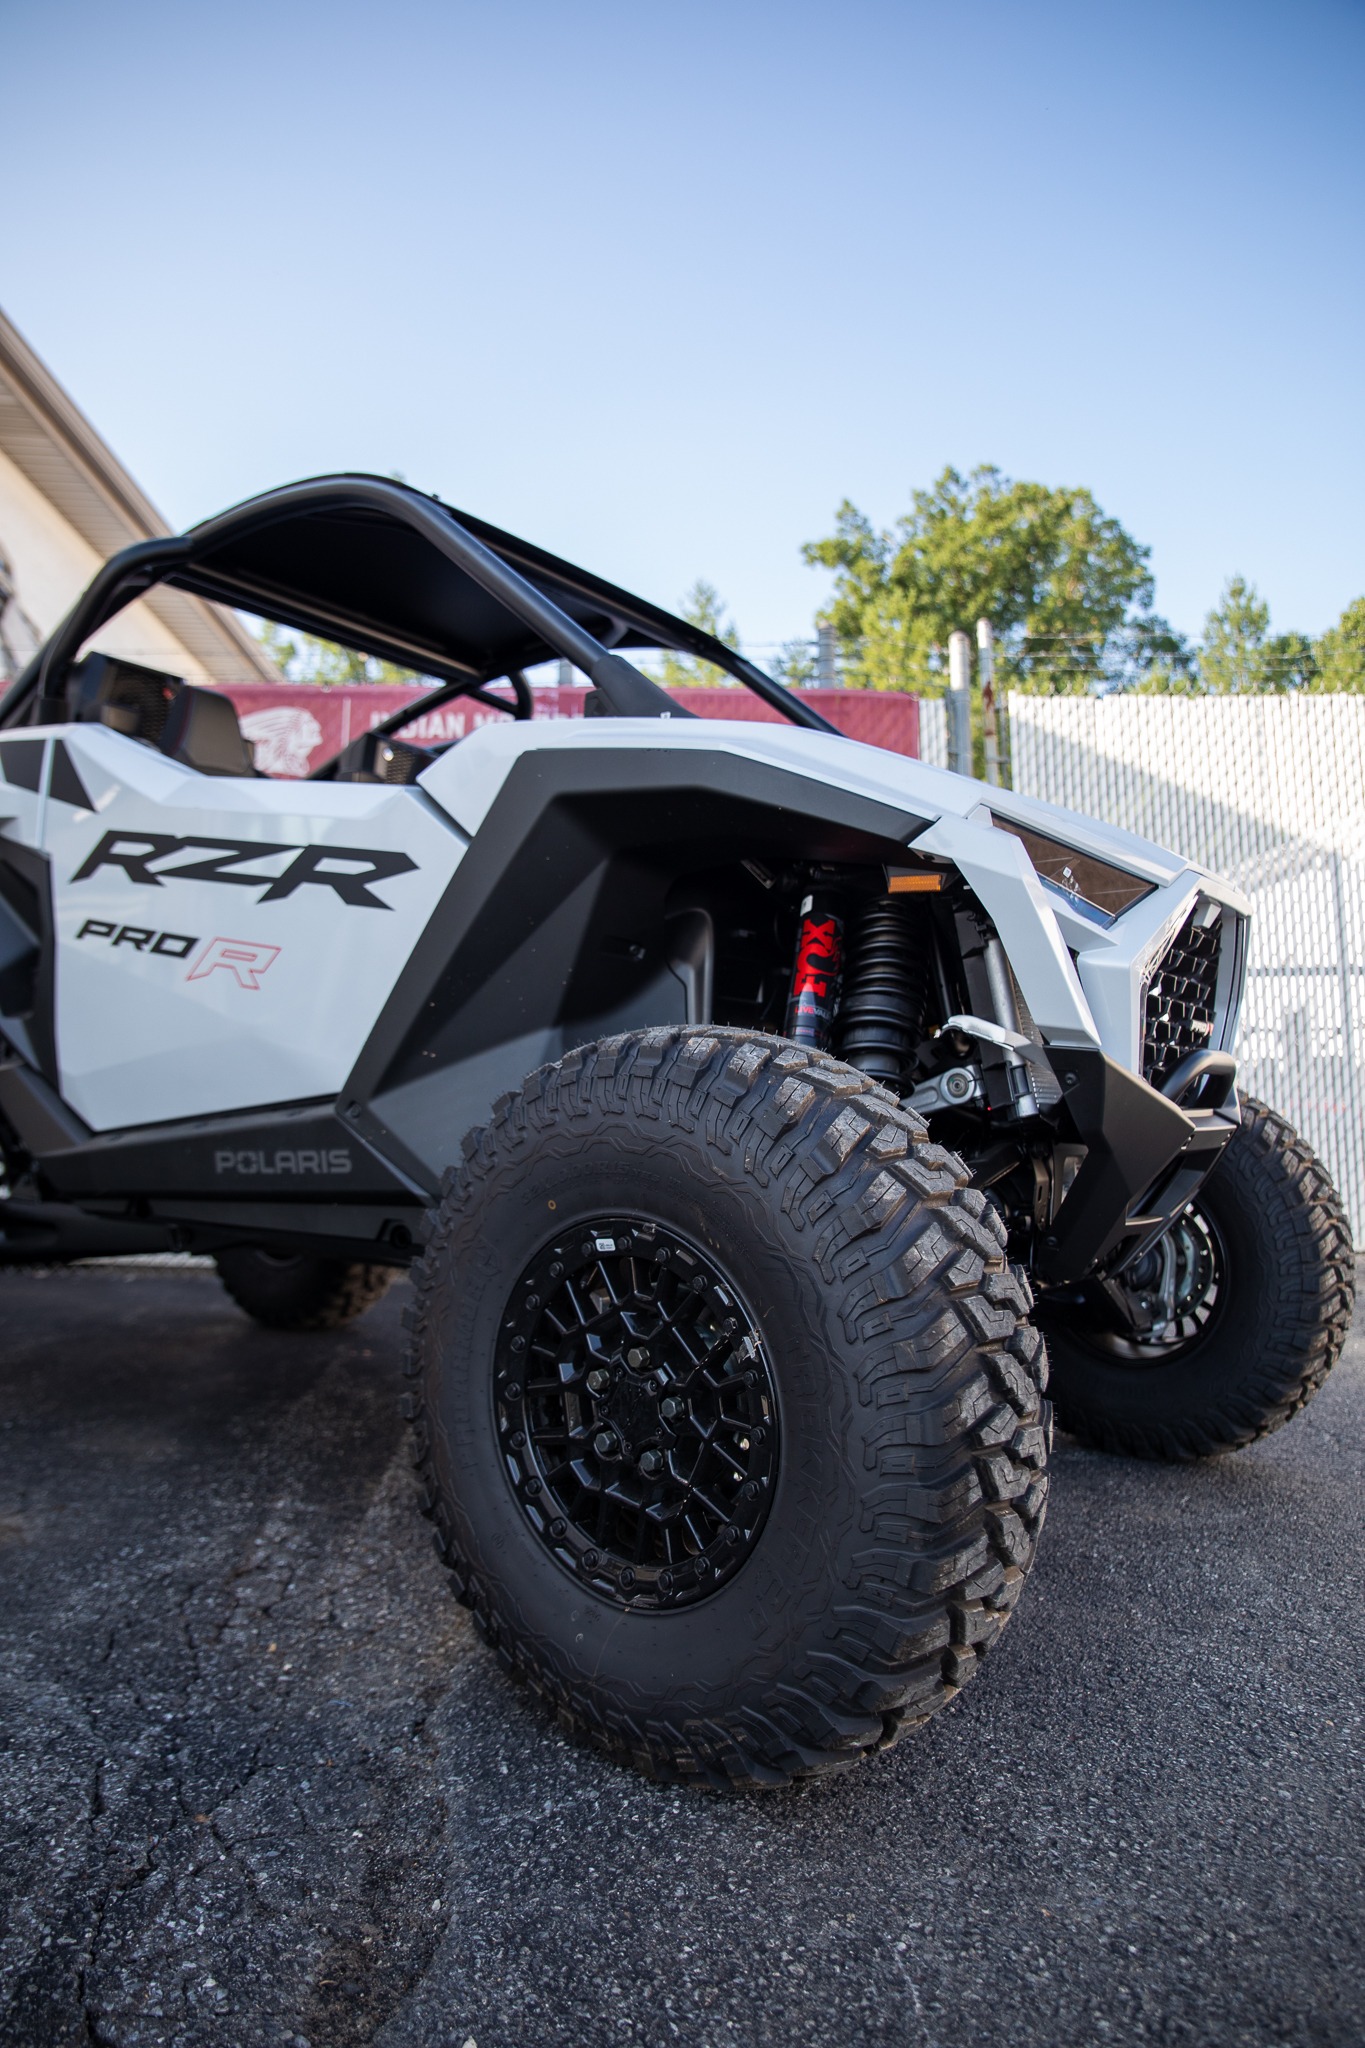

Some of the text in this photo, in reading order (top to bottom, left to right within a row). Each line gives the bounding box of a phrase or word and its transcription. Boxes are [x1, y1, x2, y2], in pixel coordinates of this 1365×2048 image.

[70, 830, 420, 910] RZR
[76, 919, 282, 991] PRO R
[793, 918, 842, 998] FOX
[214, 1149, 352, 1175] POLARIS
